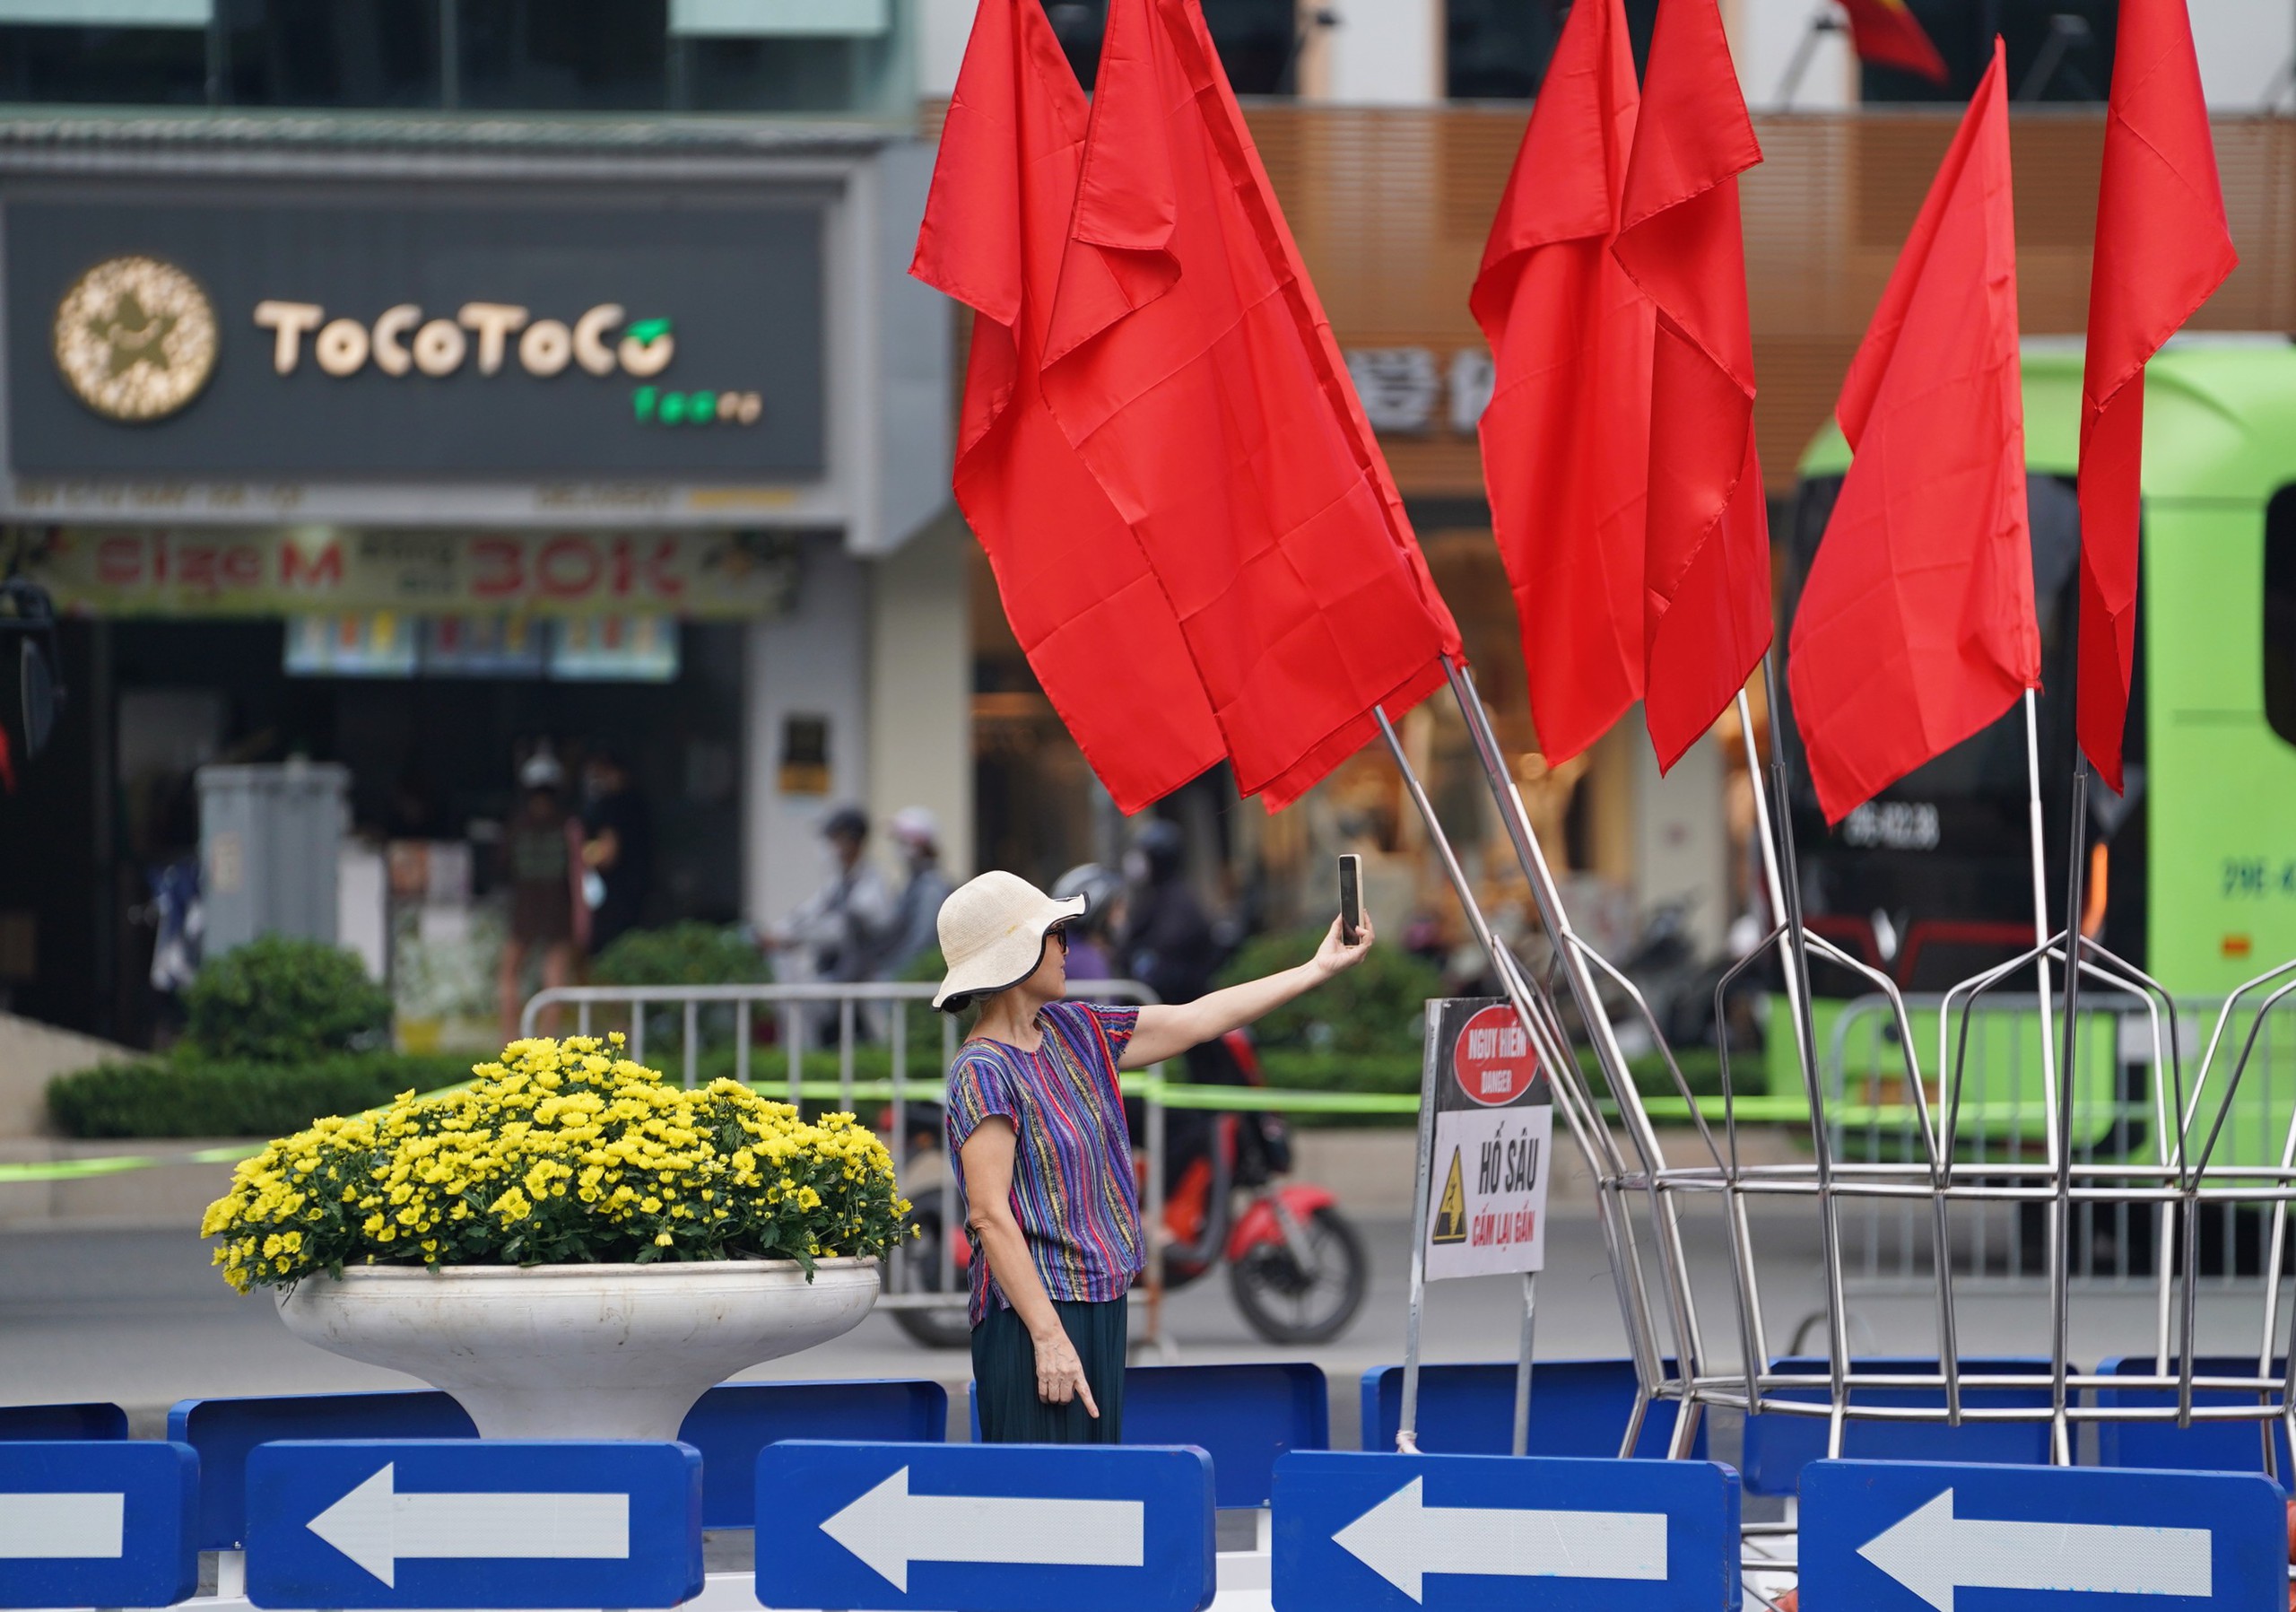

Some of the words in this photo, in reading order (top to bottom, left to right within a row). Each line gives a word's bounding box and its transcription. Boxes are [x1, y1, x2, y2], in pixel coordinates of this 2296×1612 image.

[468, 533, 689, 599] 30K
[1468, 1027, 1499, 1060] NGUY
[1481, 1069, 1512, 1094] DANGER
[1478, 1120, 1505, 1195] HỐ
[1505, 1127, 1540, 1193] SÂU
[1496, 1212, 1513, 1252] LẠI
